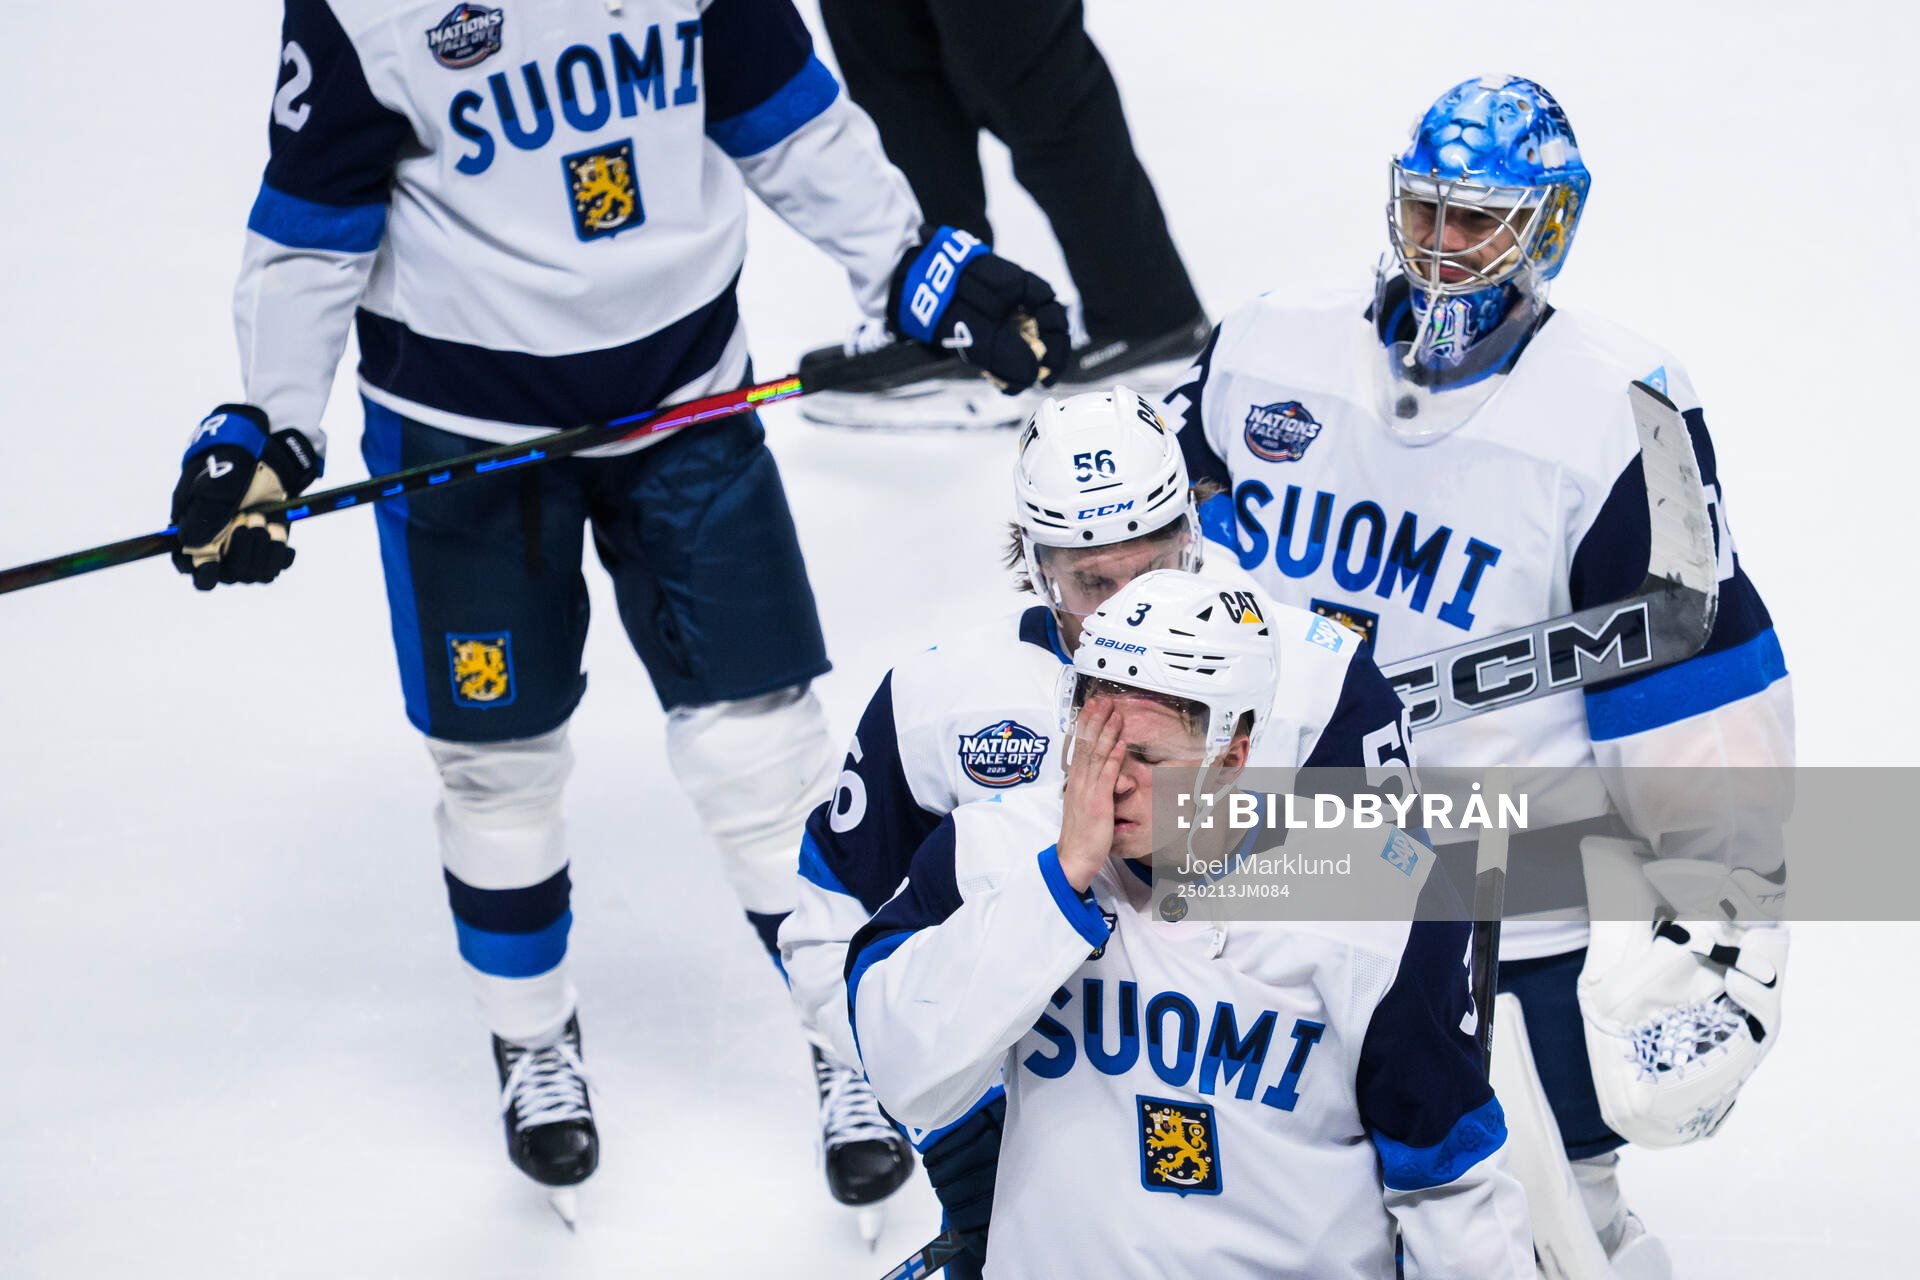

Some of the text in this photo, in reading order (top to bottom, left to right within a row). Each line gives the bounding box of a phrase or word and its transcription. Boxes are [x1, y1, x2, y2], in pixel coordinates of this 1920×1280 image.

[430, 11, 502, 46] NATIONS
[273, 41, 312, 132] 2
[449, 19, 701, 176] SUOMI
[911, 230, 982, 327] BAU
[1249, 407, 1320, 438] NATIONS
[1073, 449, 1116, 483] 56
[1077, 499, 1134, 520] CCM
[1235, 479, 1503, 632] SUOMI
[1126, 603, 1152, 627] 3
[1219, 591, 1265, 625] CAT
[962, 737, 1047, 753] NATIONS
[967, 753, 1036, 765] FACE-OFF
[1023, 978, 1326, 1112] SUOMI
